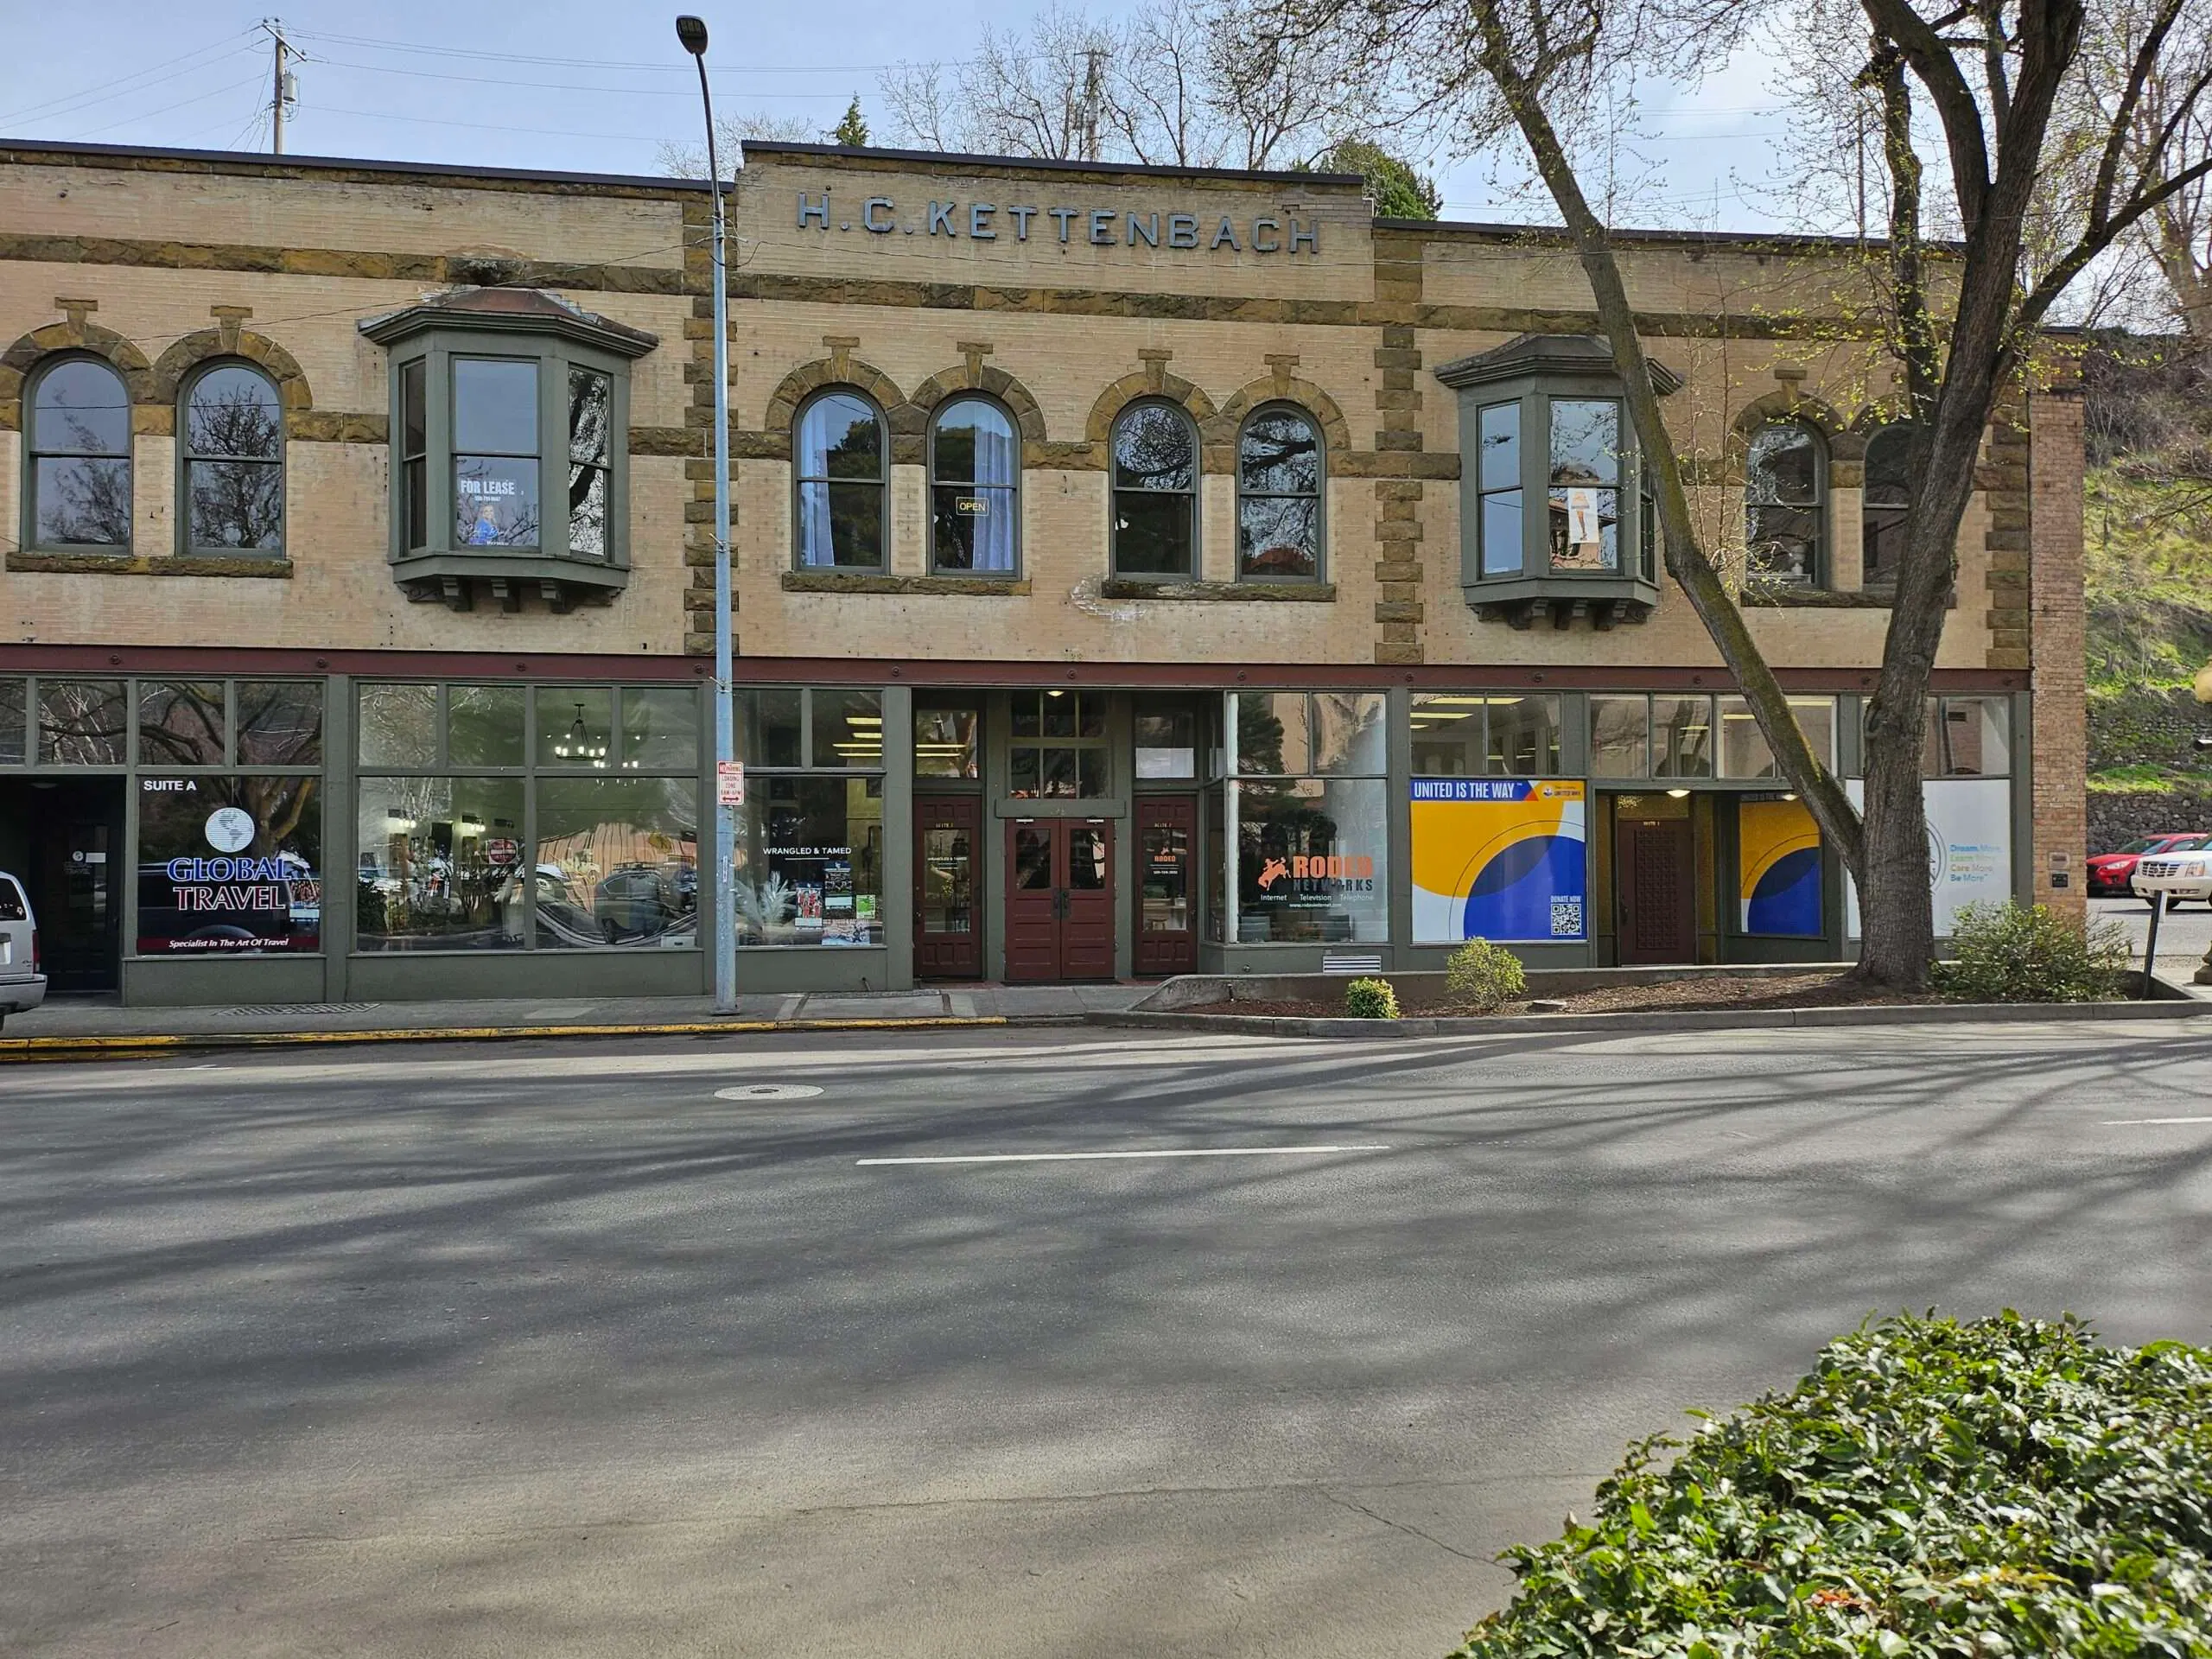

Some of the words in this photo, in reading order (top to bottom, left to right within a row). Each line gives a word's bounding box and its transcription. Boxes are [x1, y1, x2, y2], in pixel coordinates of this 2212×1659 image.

[928, 200, 1320, 254] KETTENBACH
[461, 480, 481, 493] FOR
[483, 480, 515, 495] LEASE
[959, 502, 986, 512] OPEN
[143, 780, 183, 791] SUITE
[186, 780, 197, 791] A
[1414, 782, 1454, 798] UNITED
[1456, 782, 1467, 798] IS
[1469, 782, 1490, 798] THE
[1491, 783, 1515, 798] WAY
[167, 856, 292, 881] GLOBAL
[1293, 855, 1373, 879] RODEO
[173, 887, 286, 911] TRAVEL
[168, 939, 208, 949] Specialist
[251, 938, 263, 947] Of
[264, 938, 289, 946] Travel
